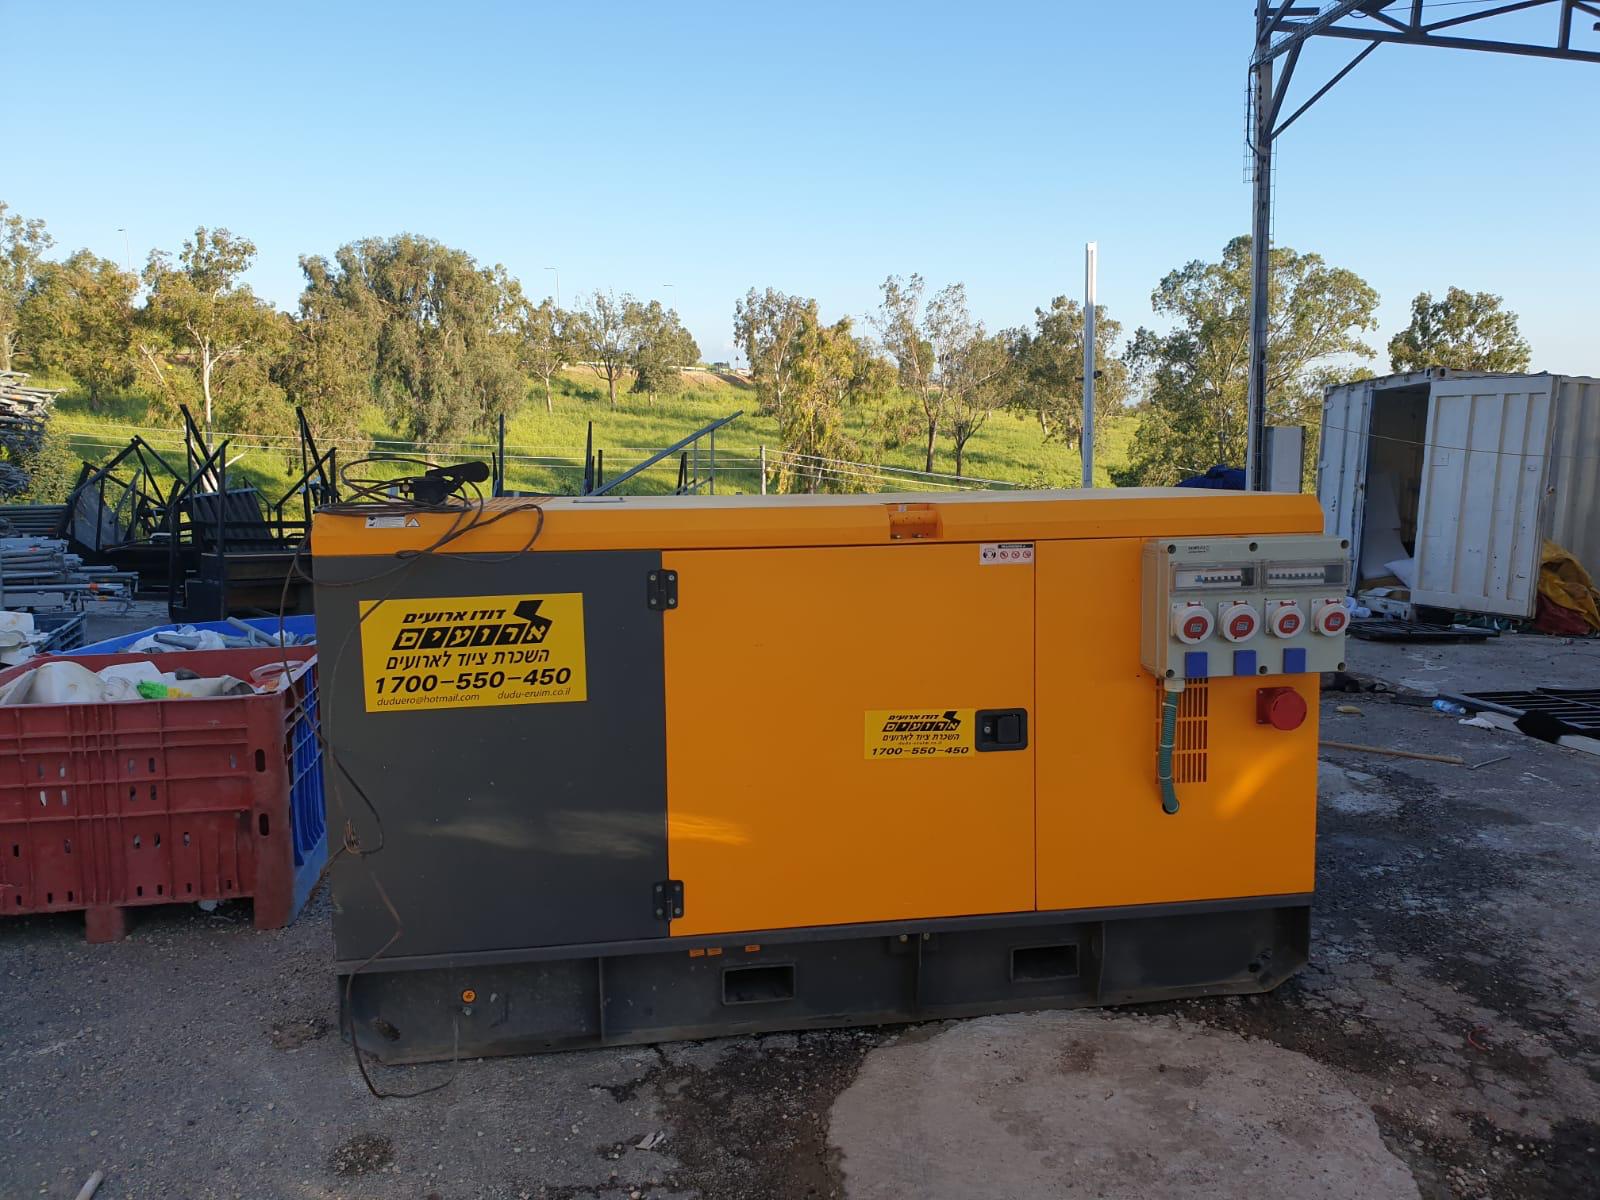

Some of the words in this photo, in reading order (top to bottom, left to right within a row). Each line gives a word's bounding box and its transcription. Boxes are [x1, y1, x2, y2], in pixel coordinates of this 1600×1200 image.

[402, 611, 467, 624] ארועים
[469, 609, 506, 620] דודו
[395, 623, 550, 648] ארועים
[386, 651, 452, 671] לארועים
[458, 652, 487, 666] ציוד
[492, 649, 550, 664] השכרת
[884, 721, 960, 731] ארועים
[883, 732, 913, 741] לארועים
[932, 733, 960, 741] השכרת
